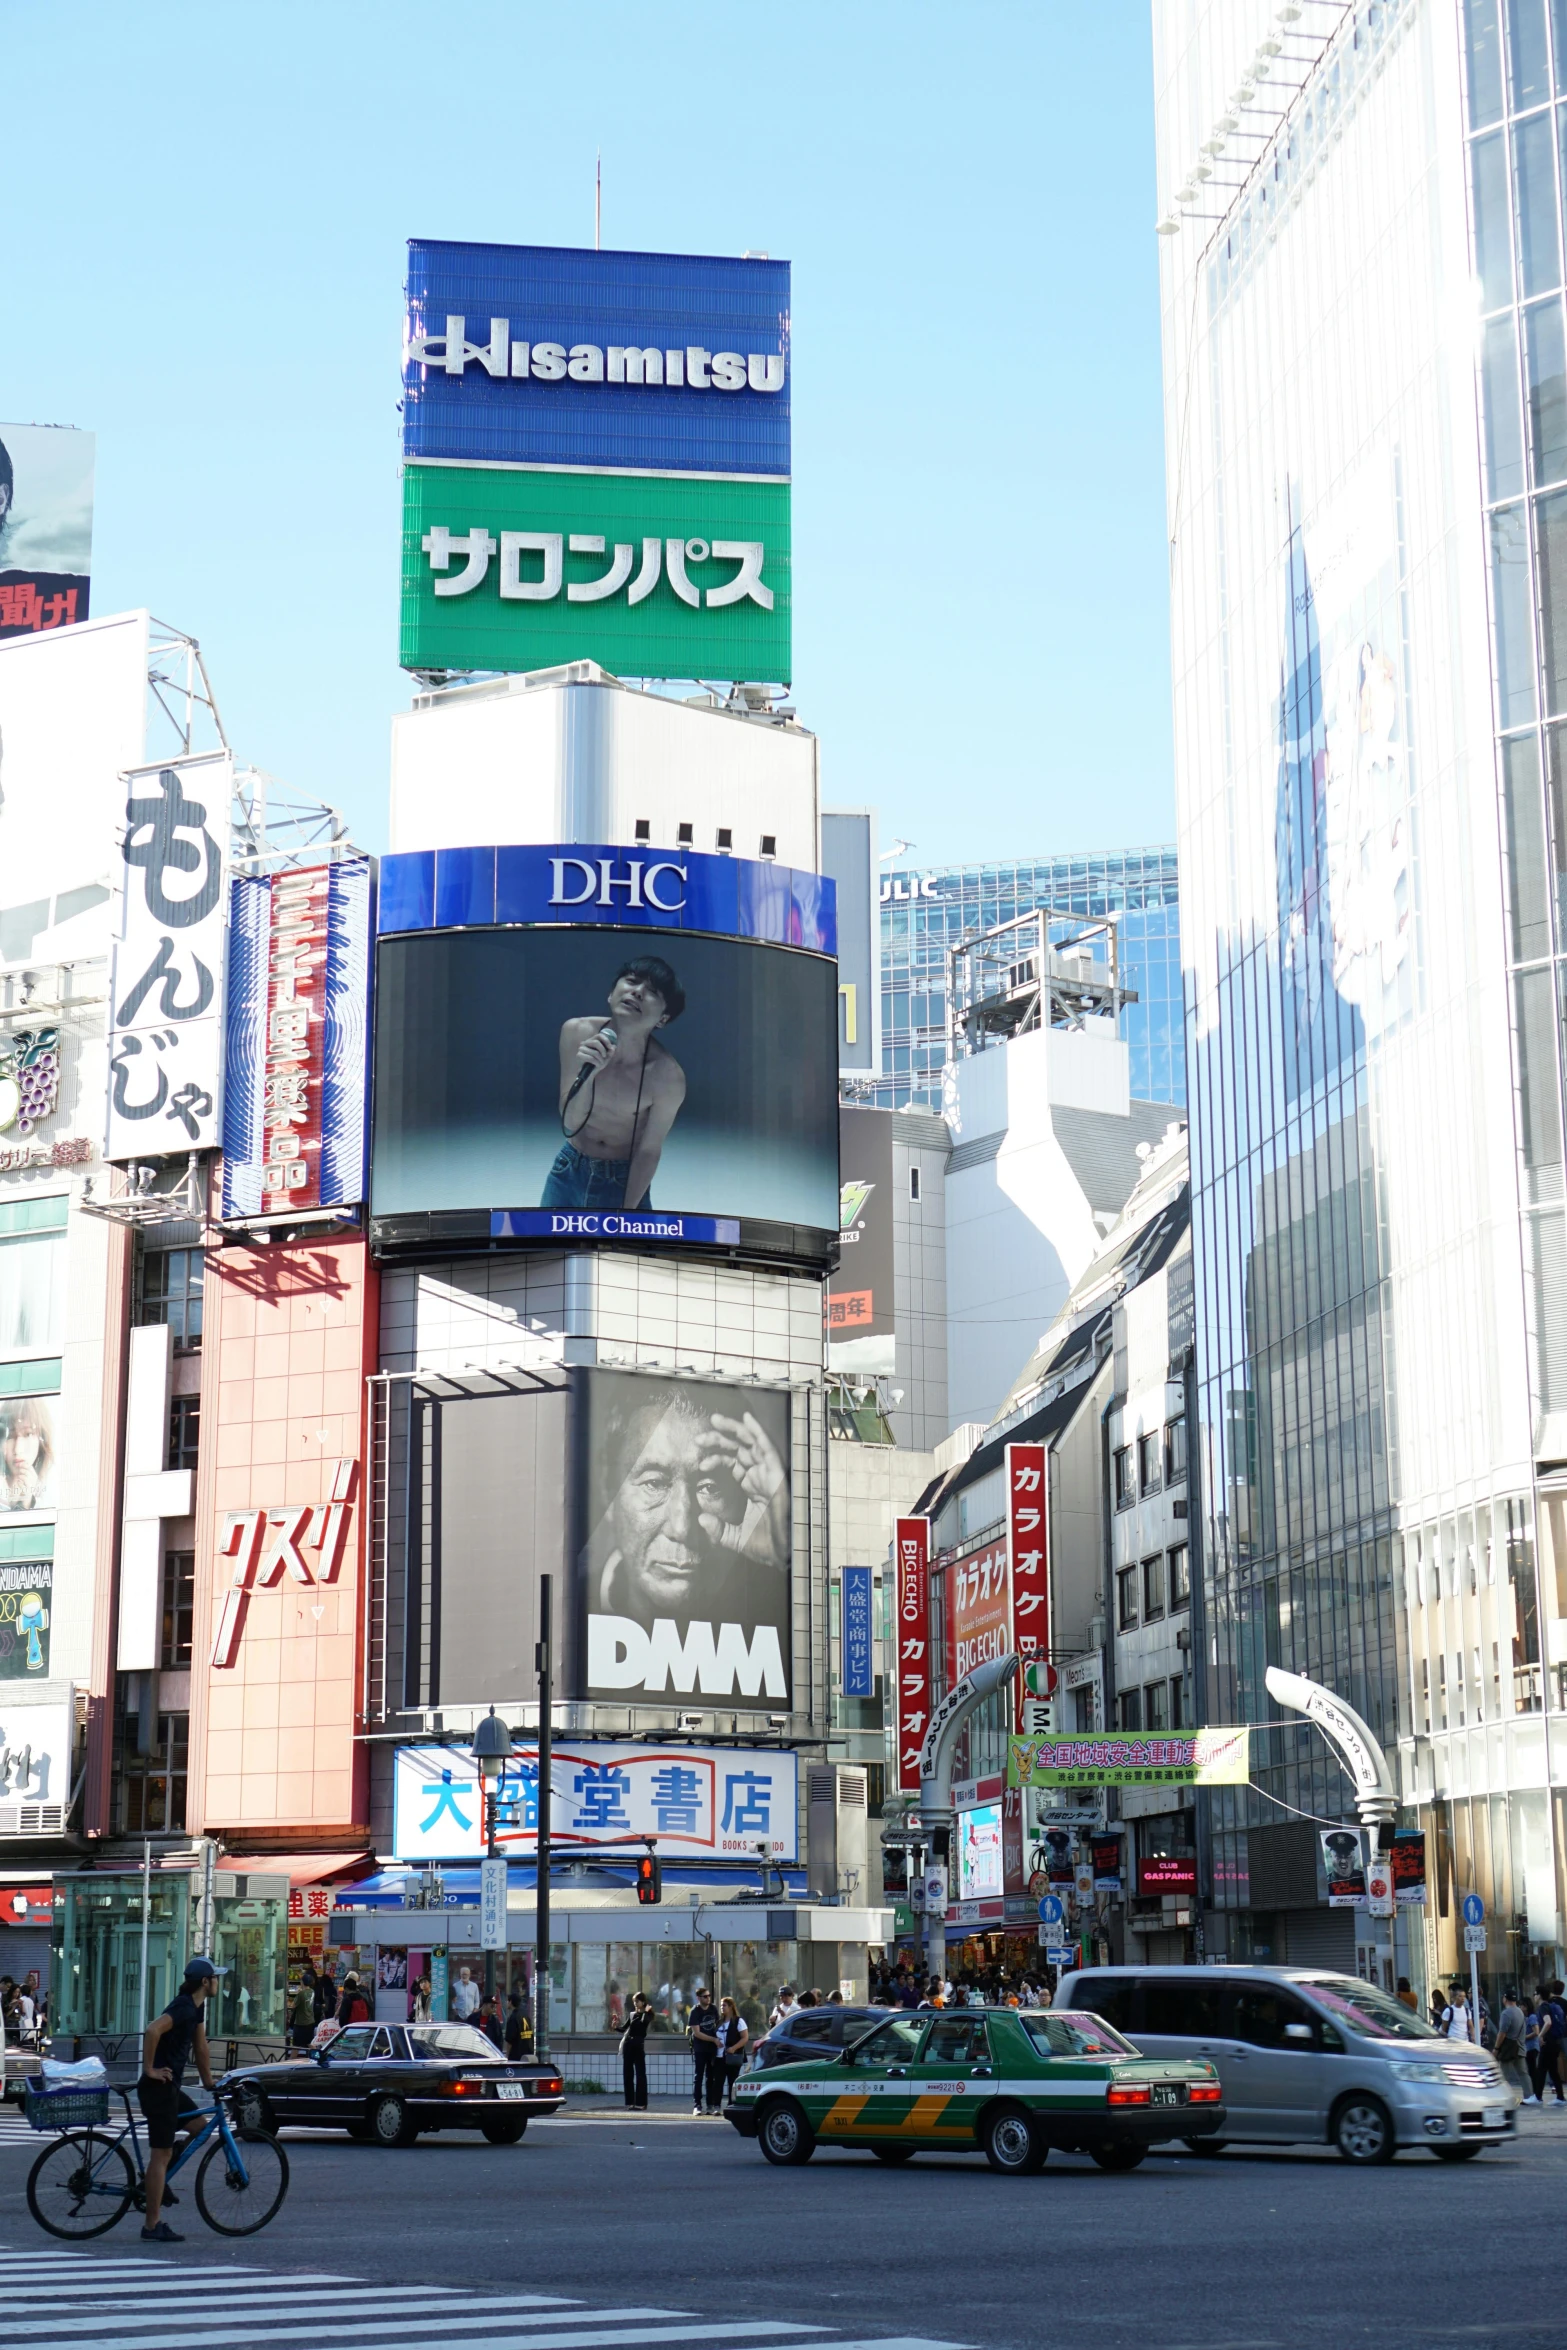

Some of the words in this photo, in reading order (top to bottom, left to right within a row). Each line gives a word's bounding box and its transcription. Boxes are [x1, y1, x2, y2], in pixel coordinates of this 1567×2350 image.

[408, 315, 785, 392] Hisamitsu
[421, 525, 774, 611] サロンパス
[548, 858, 687, 911] DHC
[111, 769, 222, 1142] もんじゃ
[261, 877, 315, 1192] 三千里薬品
[551, 1215, 599, 1233] DHC
[602, 1215, 684, 1237] Channel
[901, 1540, 918, 1572] BIG
[1013, 1466, 1044, 1617] カラオケ
[904, 1574, 919, 1622] ECHO
[956, 1550, 1007, 1614] カラオケ
[587, 1614, 788, 1698] DMM
[848, 1575, 867, 1689] 大盛堂商事ビル
[956, 1638, 977, 1686] BIG
[977, 1622, 1008, 1662] ECHO
[922, 1684, 969, 1776] 渋谷センター街
[1036, 1738, 1243, 1769] 全国地域安全運動実施中
[419, 1764, 773, 1835] 大盛堂書店
[1046, 1811, 1098, 1820] 渋谷センター街
[722, 1840, 747, 1851] BOOKS
[485, 1866, 497, 1936] 文化村通り
[834, 2117, 848, 2126] TAXI
